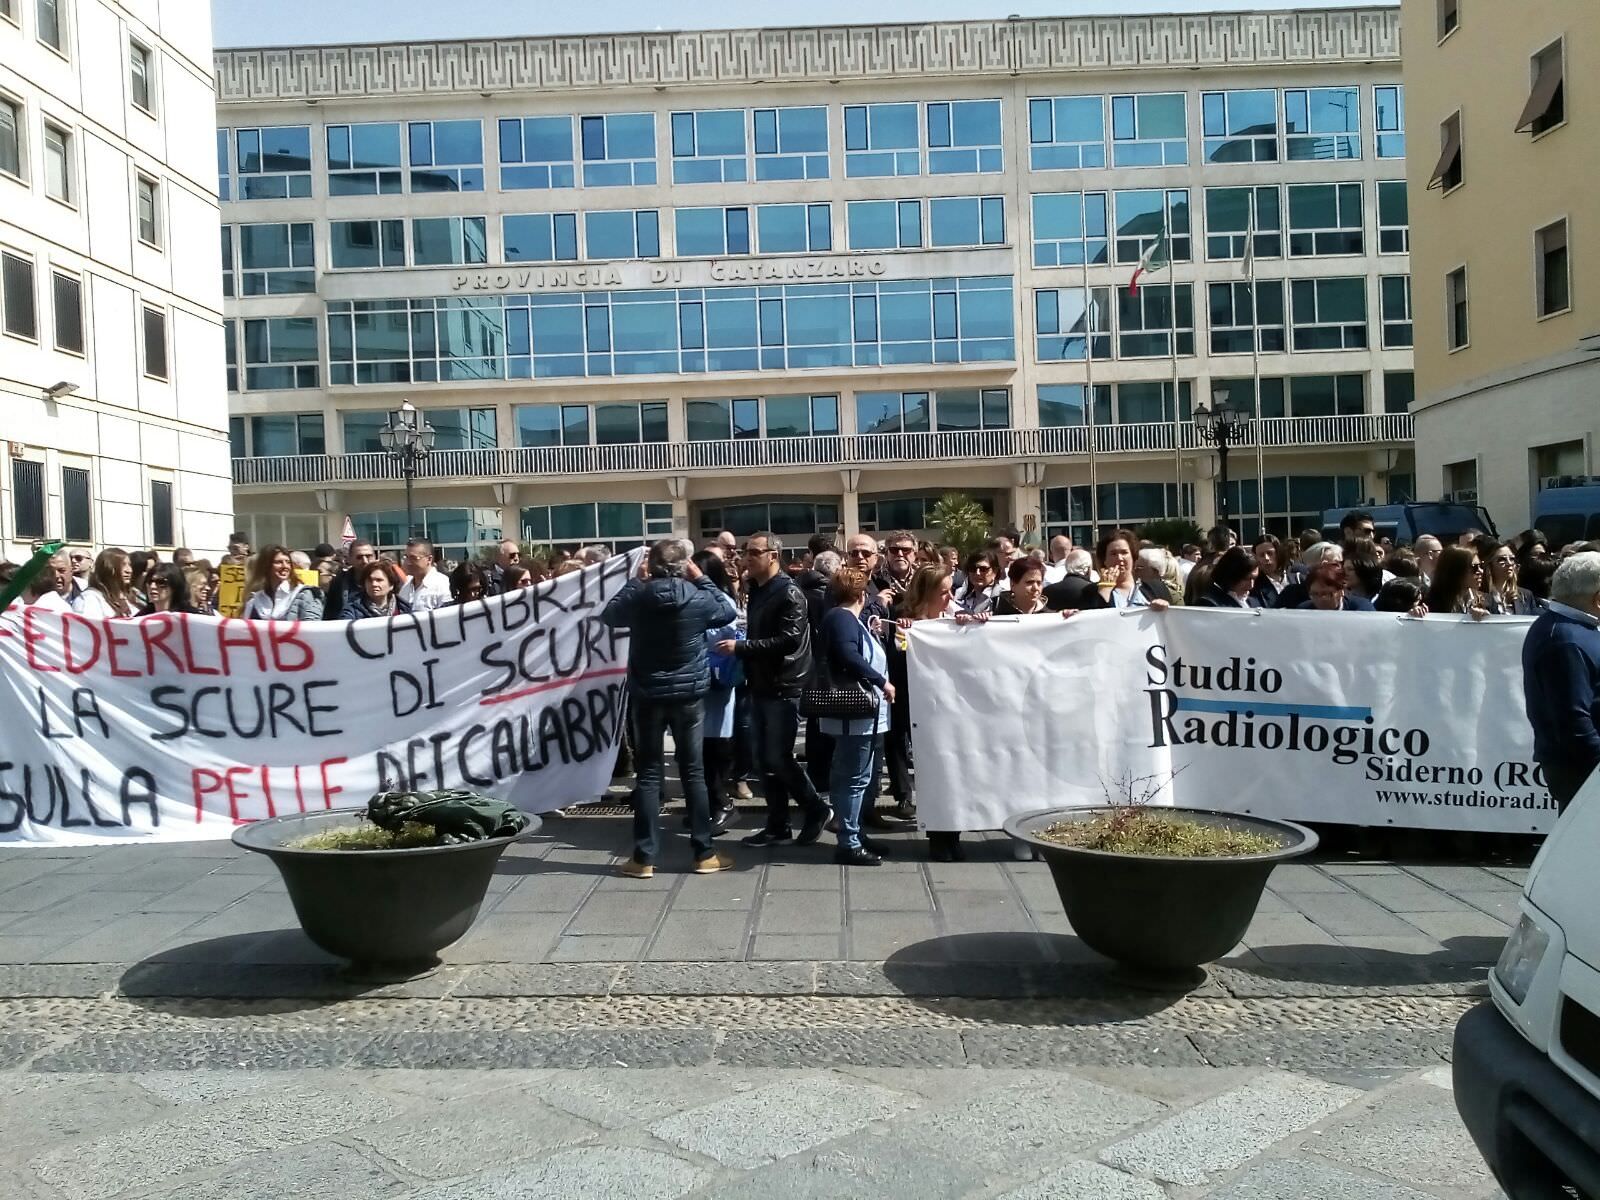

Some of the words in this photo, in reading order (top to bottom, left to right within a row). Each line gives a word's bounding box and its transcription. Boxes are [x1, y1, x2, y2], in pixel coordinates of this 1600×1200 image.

[452, 266, 622, 290] PROVINCIA
[651, 264, 682, 283] DI
[711, 259, 886, 281] CATANZARO
[346, 553, 632, 659] CALABRIA
[1145, 644, 1283, 693] Studio
[38, 686, 110, 739] LA
[150, 680, 343, 741] SCURE
[390, 658, 444, 717] DI
[1143, 688, 1430, 764] Radiologico
[0, 761, 159, 833] SULLA
[1365, 756, 1483, 785] Siderno
[1376, 789, 1557, 810] www.studiorad.it
